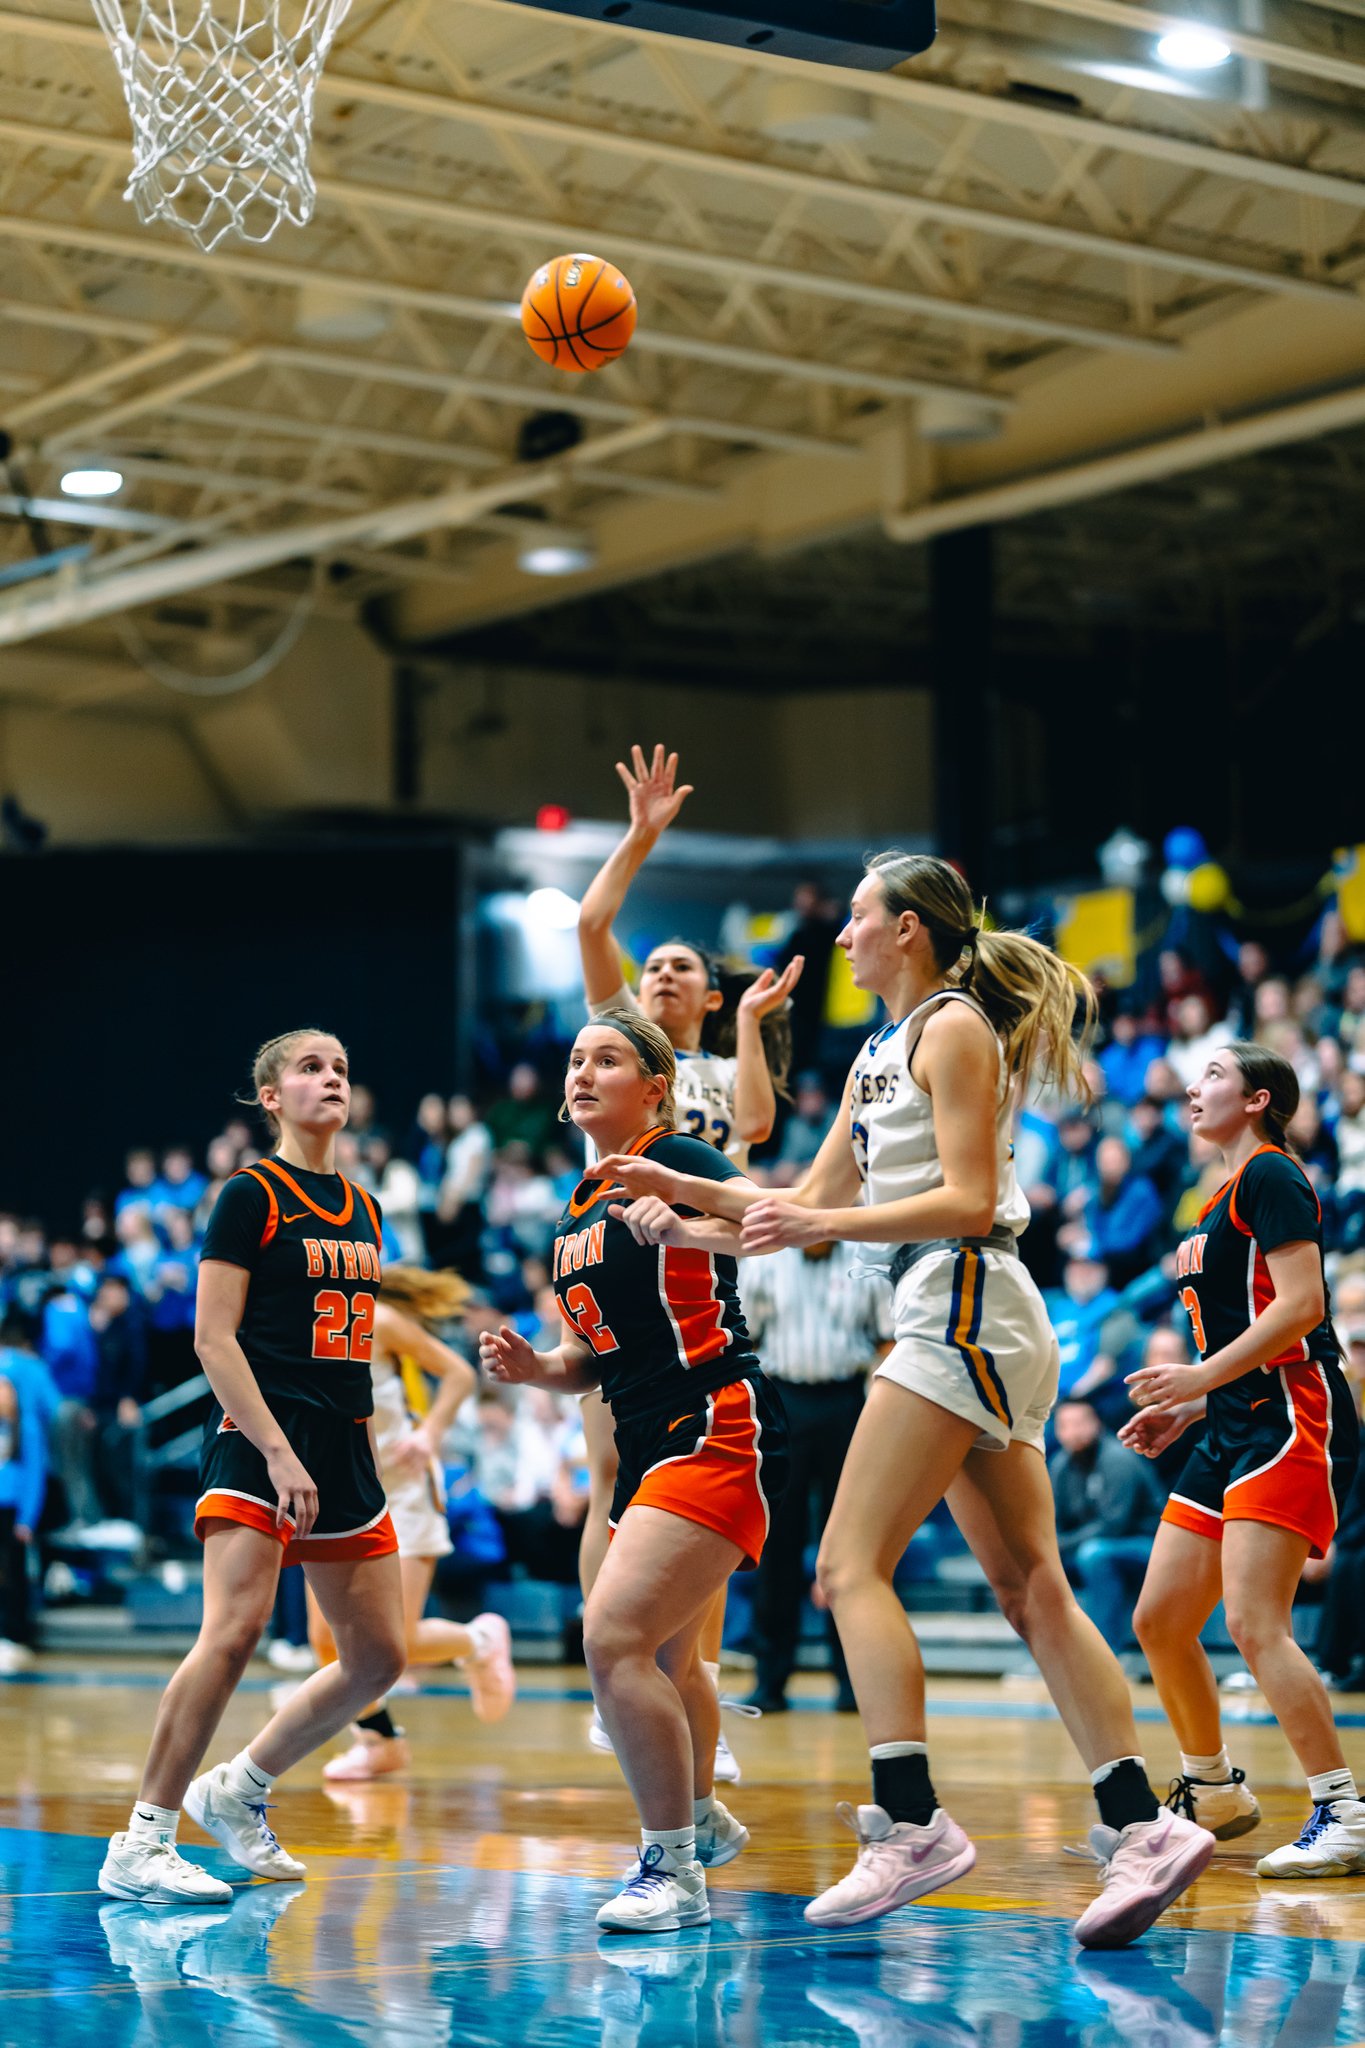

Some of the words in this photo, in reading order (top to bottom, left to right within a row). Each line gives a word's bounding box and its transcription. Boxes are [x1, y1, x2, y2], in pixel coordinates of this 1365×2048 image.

[302, 1238, 382, 1283] BYRON
[553, 1219, 607, 1282] YRON
[311, 1289, 376, 1363] 22
[555, 1282, 621, 1357] 2
[1178, 1286, 1208, 1354] 3
